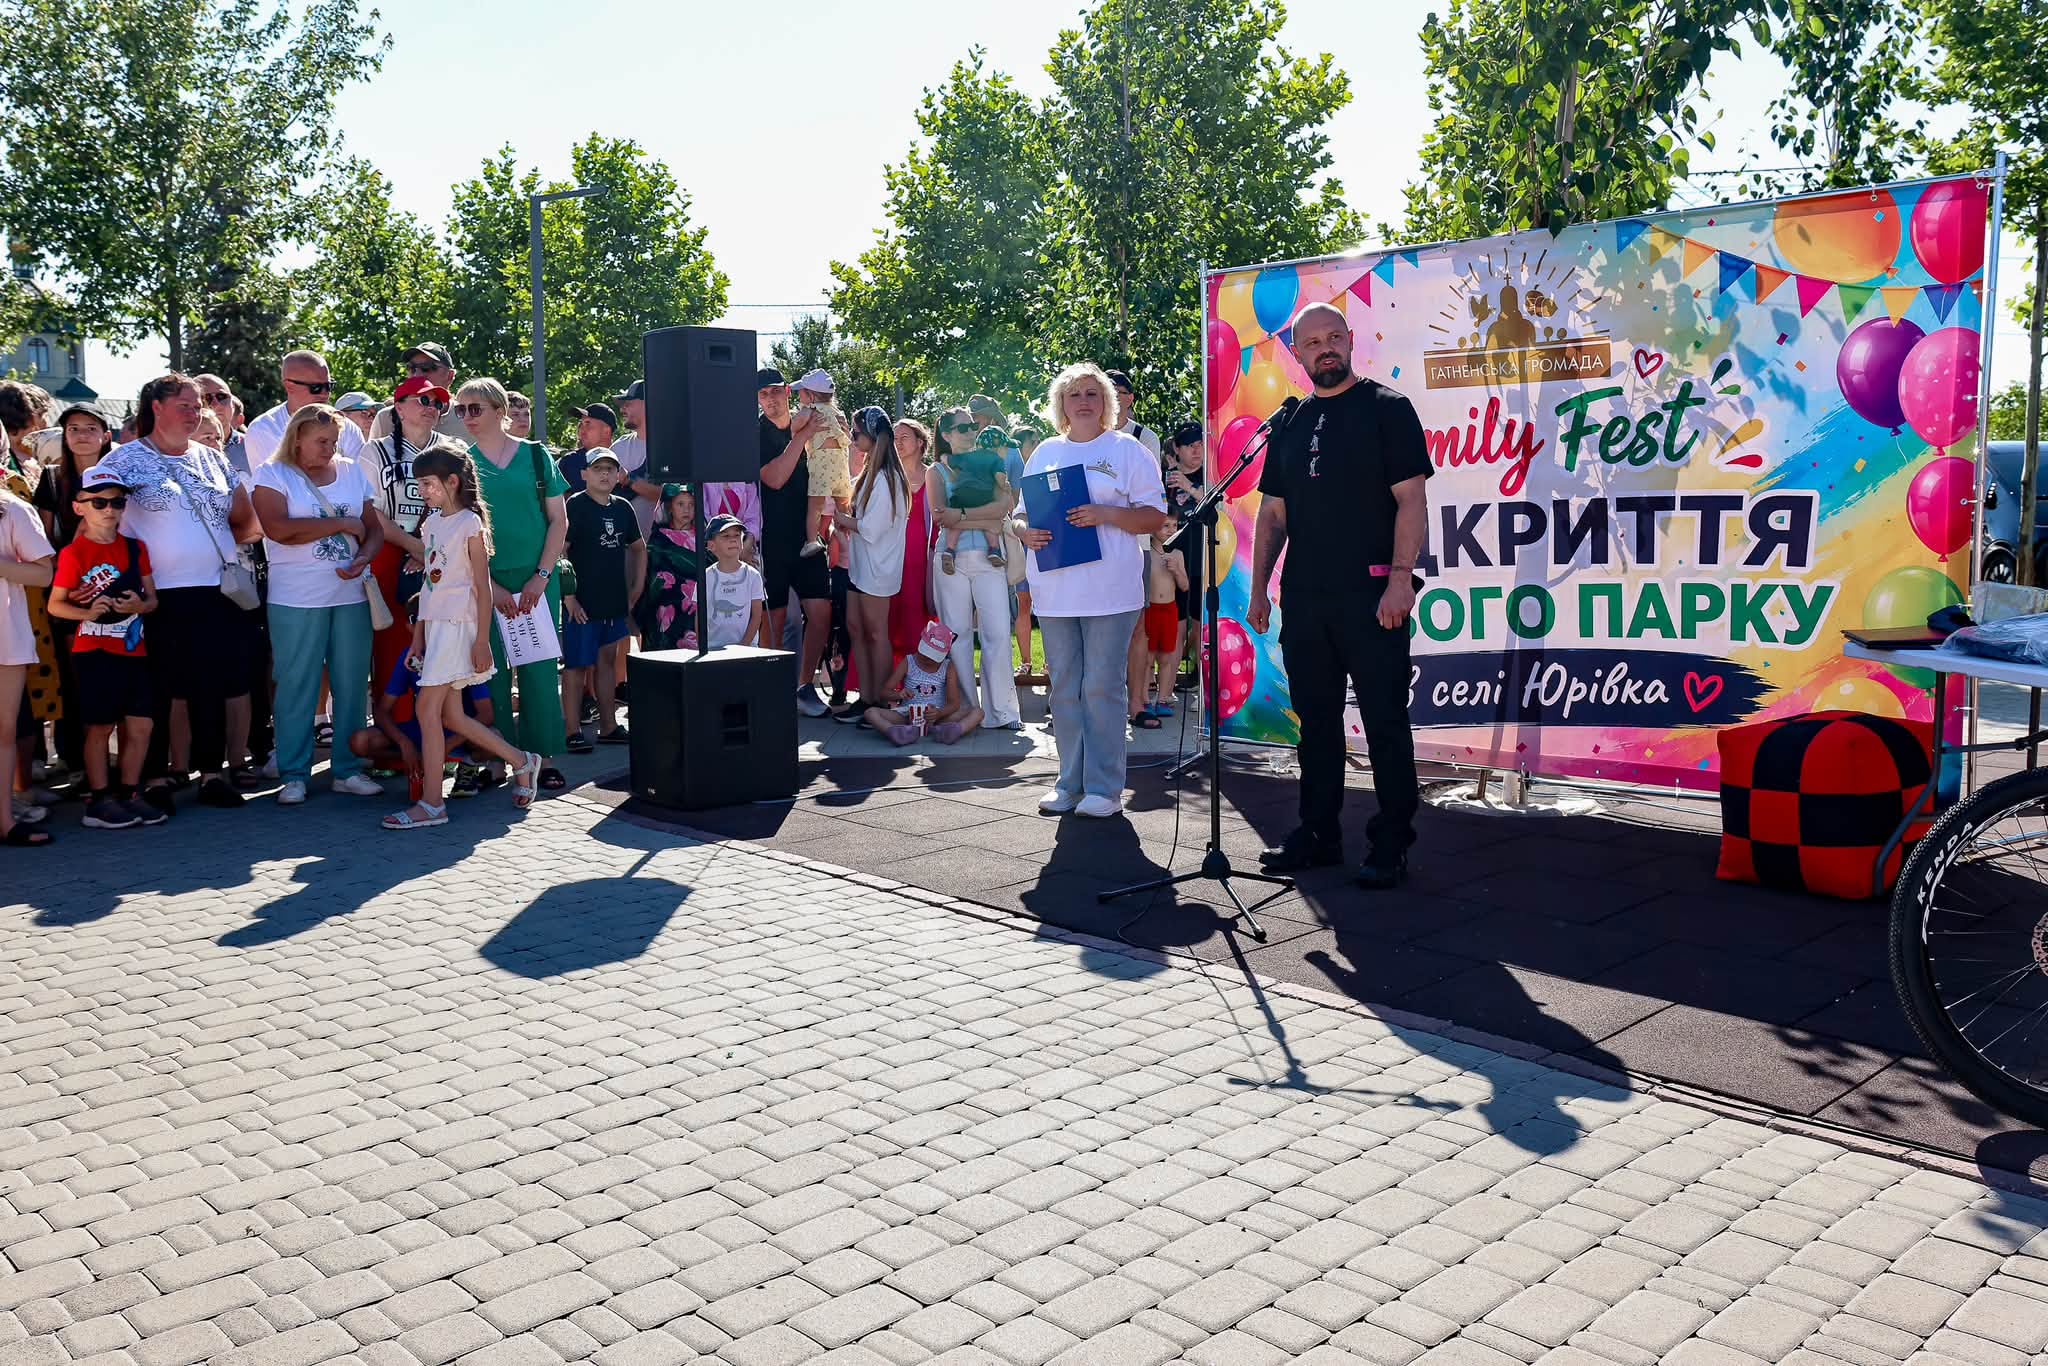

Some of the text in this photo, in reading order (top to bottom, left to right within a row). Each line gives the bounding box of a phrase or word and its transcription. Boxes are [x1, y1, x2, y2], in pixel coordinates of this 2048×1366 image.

[1430, 354, 1605, 380] ГАТНЕНСЬКА ГРОМАДА
[1424, 381, 1706, 497] mily Fest
[1412, 495, 1814, 578] КРИТТЯ
[526, 615, 541, 648] ЛОТЕРЕ
[1410, 582, 1836, 646] ОГО ПАРКУ
[1432, 670, 1506, 707] селі
[1522, 661, 1670, 719] Юрівка
[1917, 822, 1973, 905] KENDA
